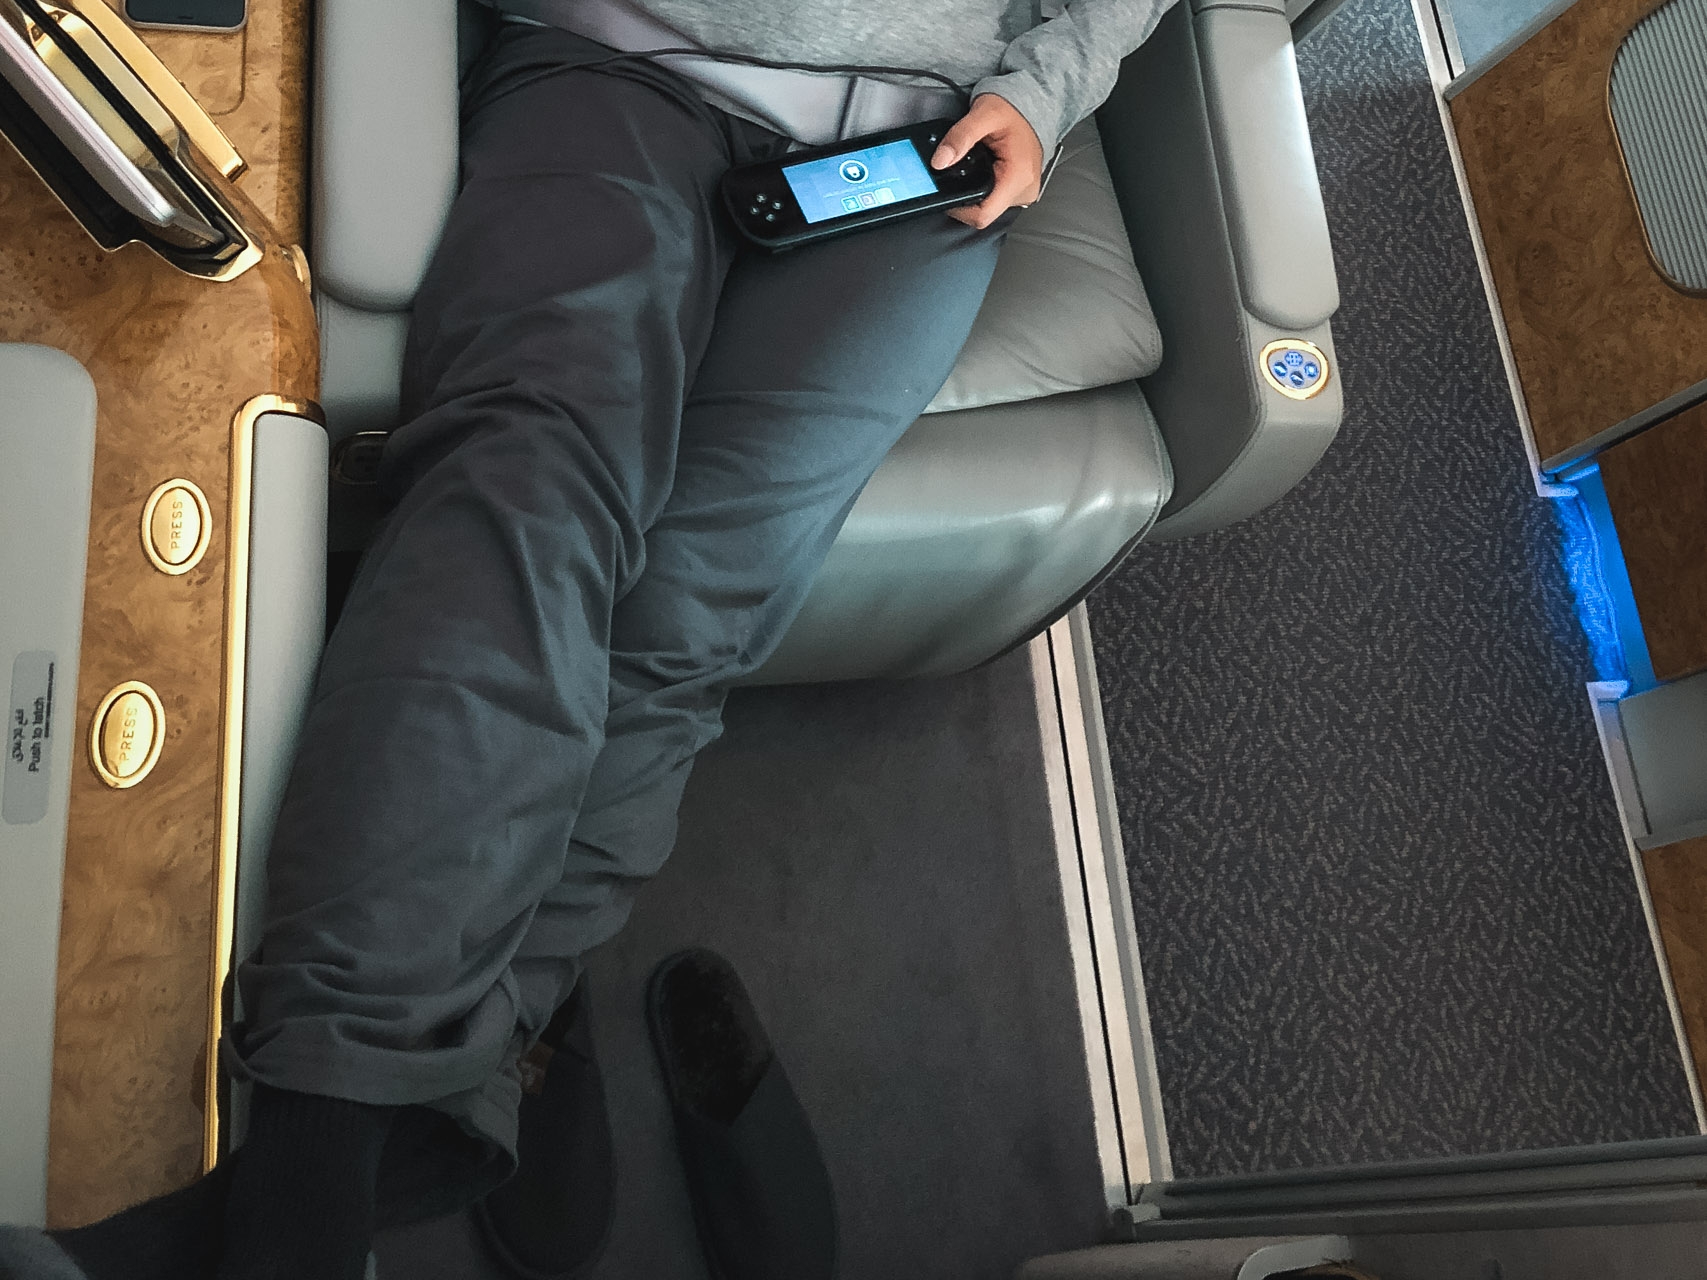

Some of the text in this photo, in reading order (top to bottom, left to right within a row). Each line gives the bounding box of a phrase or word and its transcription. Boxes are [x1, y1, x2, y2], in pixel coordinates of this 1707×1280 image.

[170, 501, 183, 549] PRESS
[28, 697, 44, 772] Push to latch
[119, 707, 137, 761] PRESS
